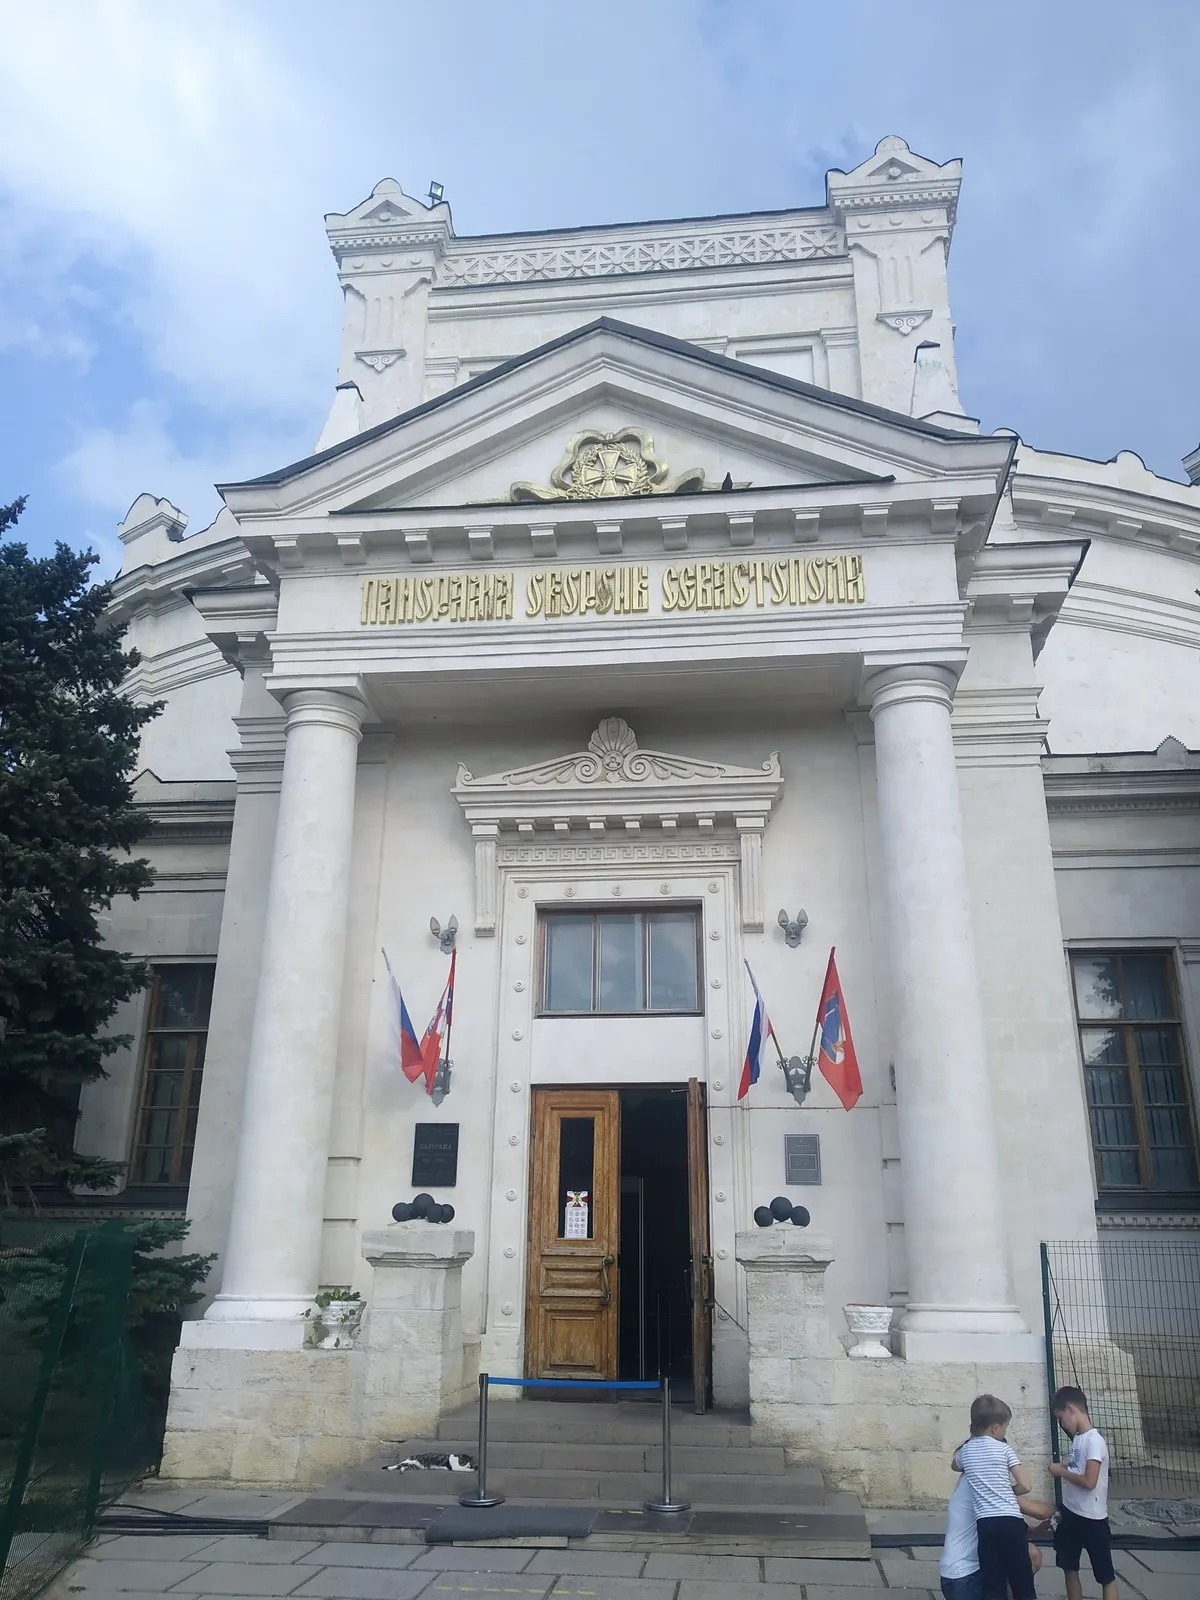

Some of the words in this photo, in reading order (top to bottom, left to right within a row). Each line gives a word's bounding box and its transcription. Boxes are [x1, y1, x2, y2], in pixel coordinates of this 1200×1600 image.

[361, 573, 514, 625] ПАНОРАМА
[526, 567, 649, 617] ОБОРОНЫ
[662, 555, 865, 611] СЕВАСТОПОЛЯ
